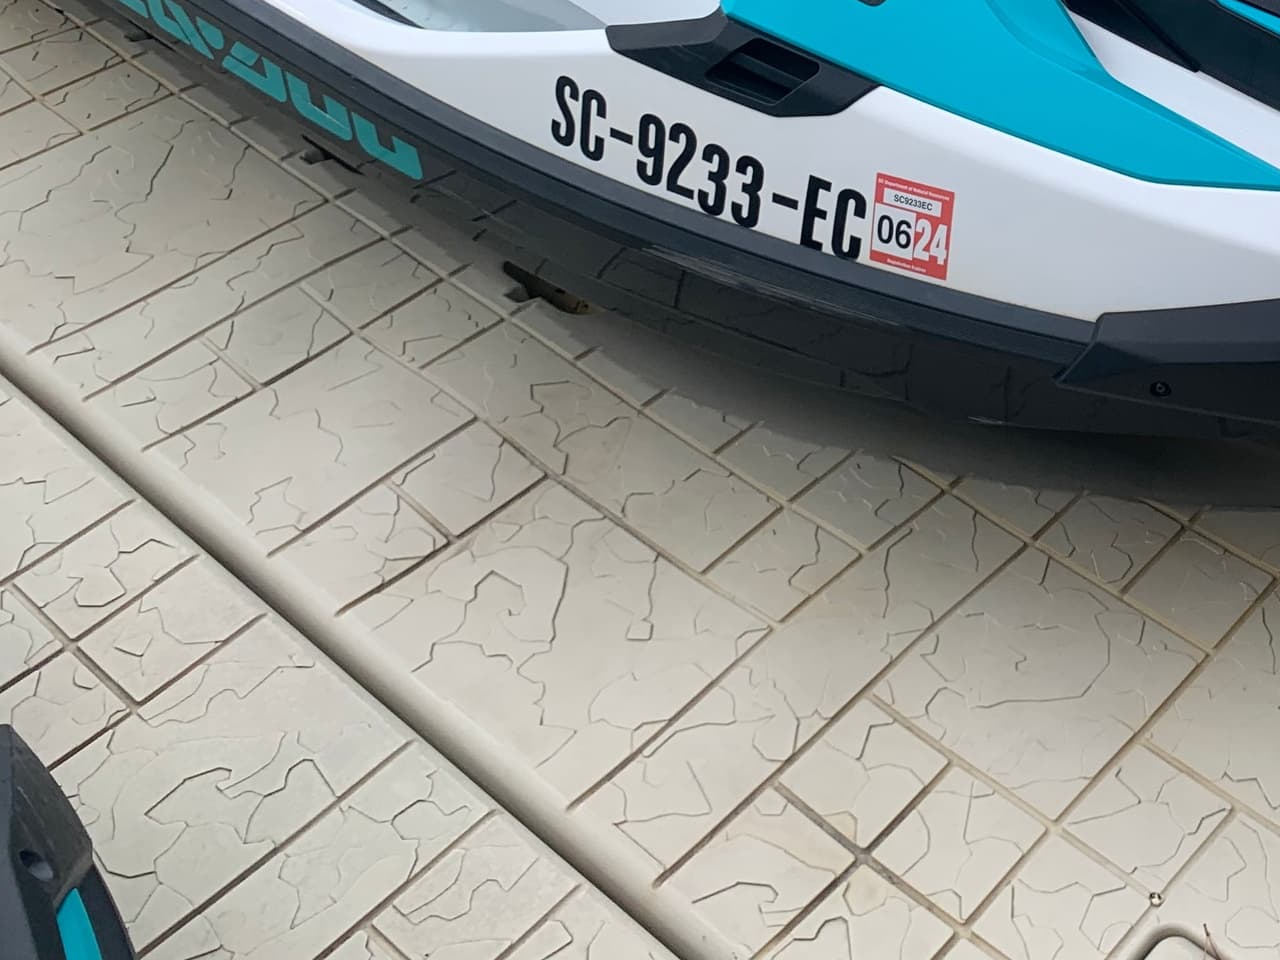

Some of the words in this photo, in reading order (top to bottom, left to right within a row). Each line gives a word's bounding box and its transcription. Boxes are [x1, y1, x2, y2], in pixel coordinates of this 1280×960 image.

[550, 75, 867, 261] SC-9233-EC
[893, 193, 933, 212] SC9233EC
[877, 214, 912, 249] 06
[913, 218, 949, 265] 24
